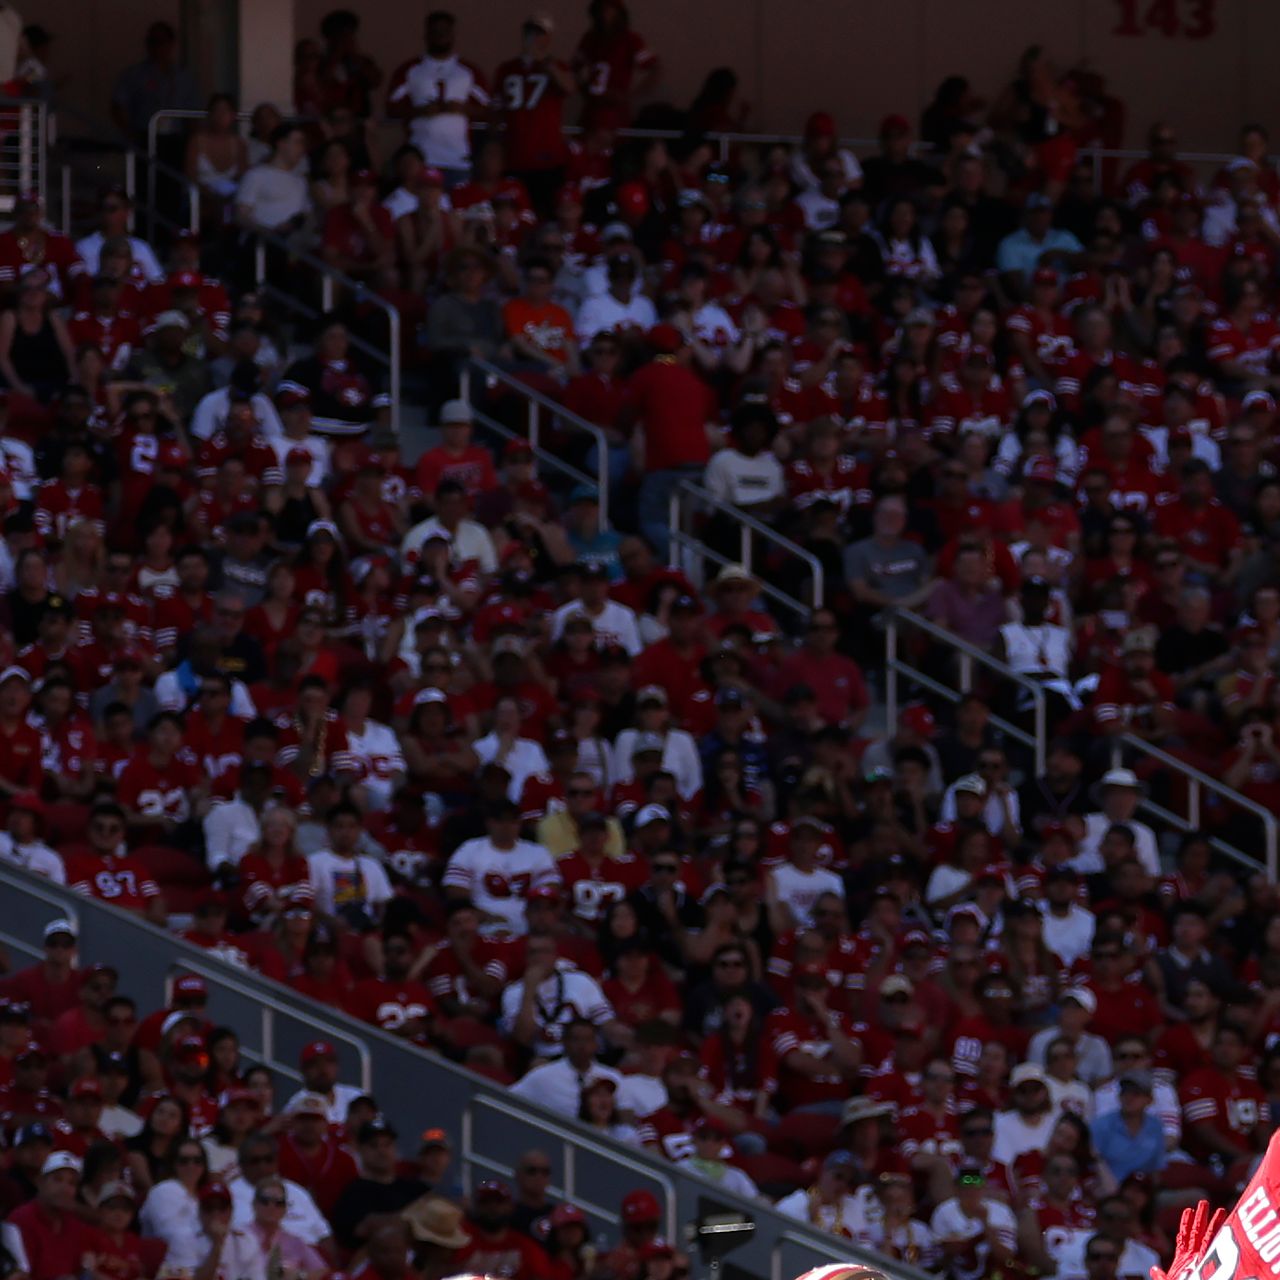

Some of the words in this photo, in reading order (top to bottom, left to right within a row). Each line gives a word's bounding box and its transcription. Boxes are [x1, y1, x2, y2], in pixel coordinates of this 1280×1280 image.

[1112, 0, 1216, 39] 143
[503, 73, 548, 110] 97
[128, 433, 160, 473] 2
